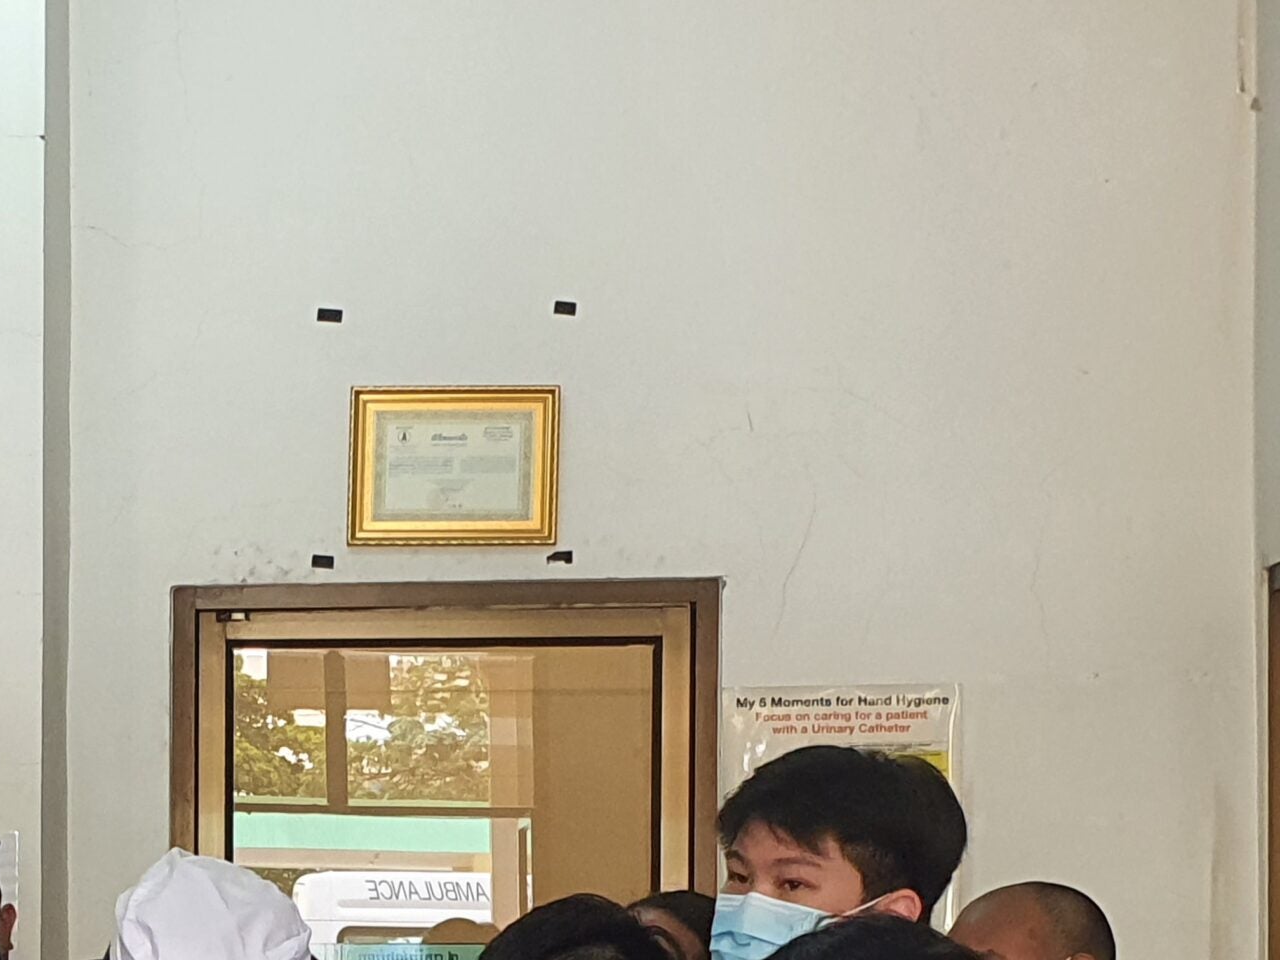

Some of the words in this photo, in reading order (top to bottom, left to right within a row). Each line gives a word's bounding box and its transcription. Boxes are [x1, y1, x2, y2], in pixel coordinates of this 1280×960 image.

[736, 698, 755, 710] My
[758, 698, 767, 708] 5
[770, 697, 832, 708] Moments
[836, 696, 854, 707] for
[858, 696, 892, 706] Hand
[896, 696, 950, 708] Hygiene
[756, 712, 792, 722] Focus
[795, 713, 810, 722] on
[814, 712, 852, 724] caring
[855, 711, 872, 721] for
[885, 710, 928, 722] patient
[772, 724, 798, 734] with
[800, 726, 808, 734] a
[812, 724, 855, 736] Urinary
[858, 723, 911, 734] Catheter
